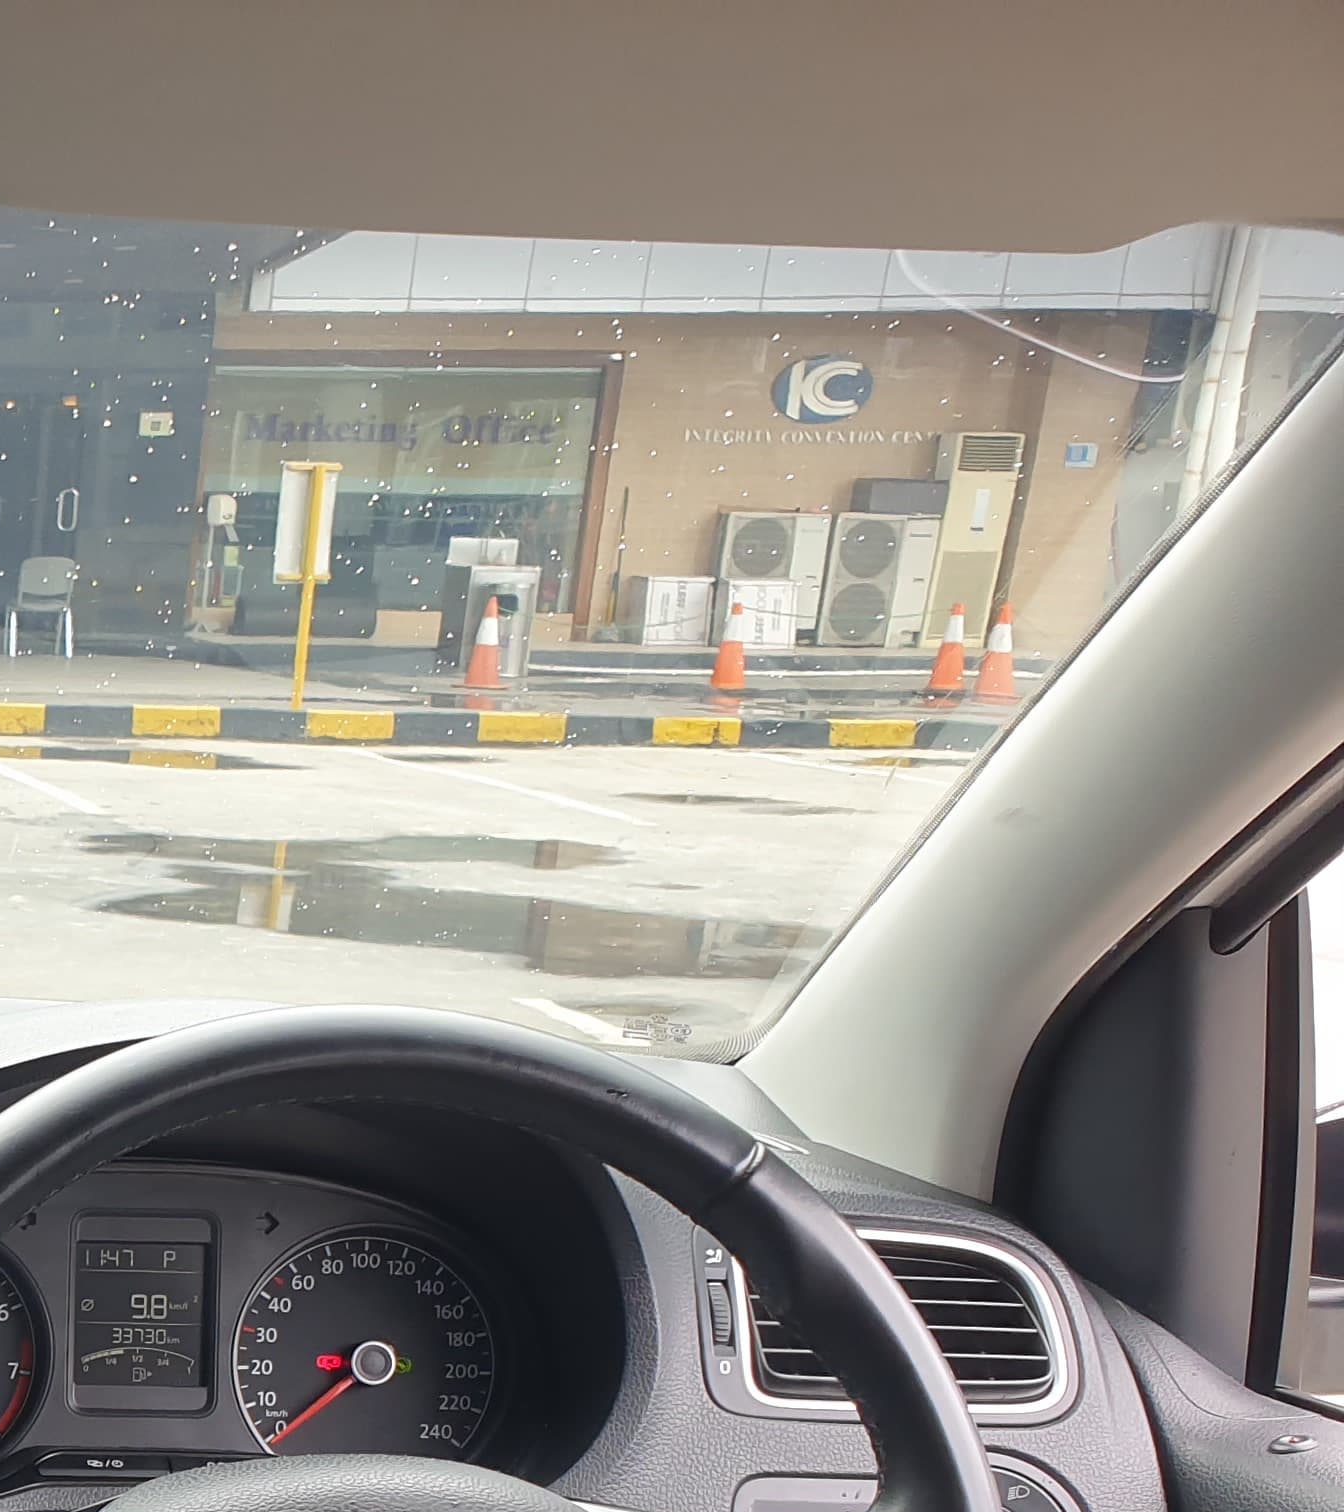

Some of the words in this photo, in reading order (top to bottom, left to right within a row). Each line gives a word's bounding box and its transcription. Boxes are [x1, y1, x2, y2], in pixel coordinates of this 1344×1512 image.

[244, 413, 419, 451] Marketing
[443, 414, 558, 445] Office
[684, 427, 773, 443] INTEGRITY
[780, 430, 885, 445] CONVENTION
[163, 1250, 176, 1268] P
[321, 1259, 344, 1275] 80
[350, 1253, 381, 1269] 100
[387, 1260, 416, 1276] 120
[291, 1275, 315, 1291] 60
[415, 1280, 444, 1296] 140
[130, 1294, 167, 1320] 9.8
[268, 1297, 292, 1313] 40
[434, 1304, 464, 1320] 160
[112, 1327, 167, 1345] 33730
[255, 1327, 278, 1343] 30
[446, 1331, 476, 1347] 180
[7, 1362, 20, 1380] 7
[250, 1359, 273, 1376] 20
[445, 1363, 478, 1379] 200
[257, 1391, 277, 1408] 10
[439, 1394, 472, 1411] 220
[265, 1408, 289, 1418] km/h
[419, 1423, 453, 1440] 240
